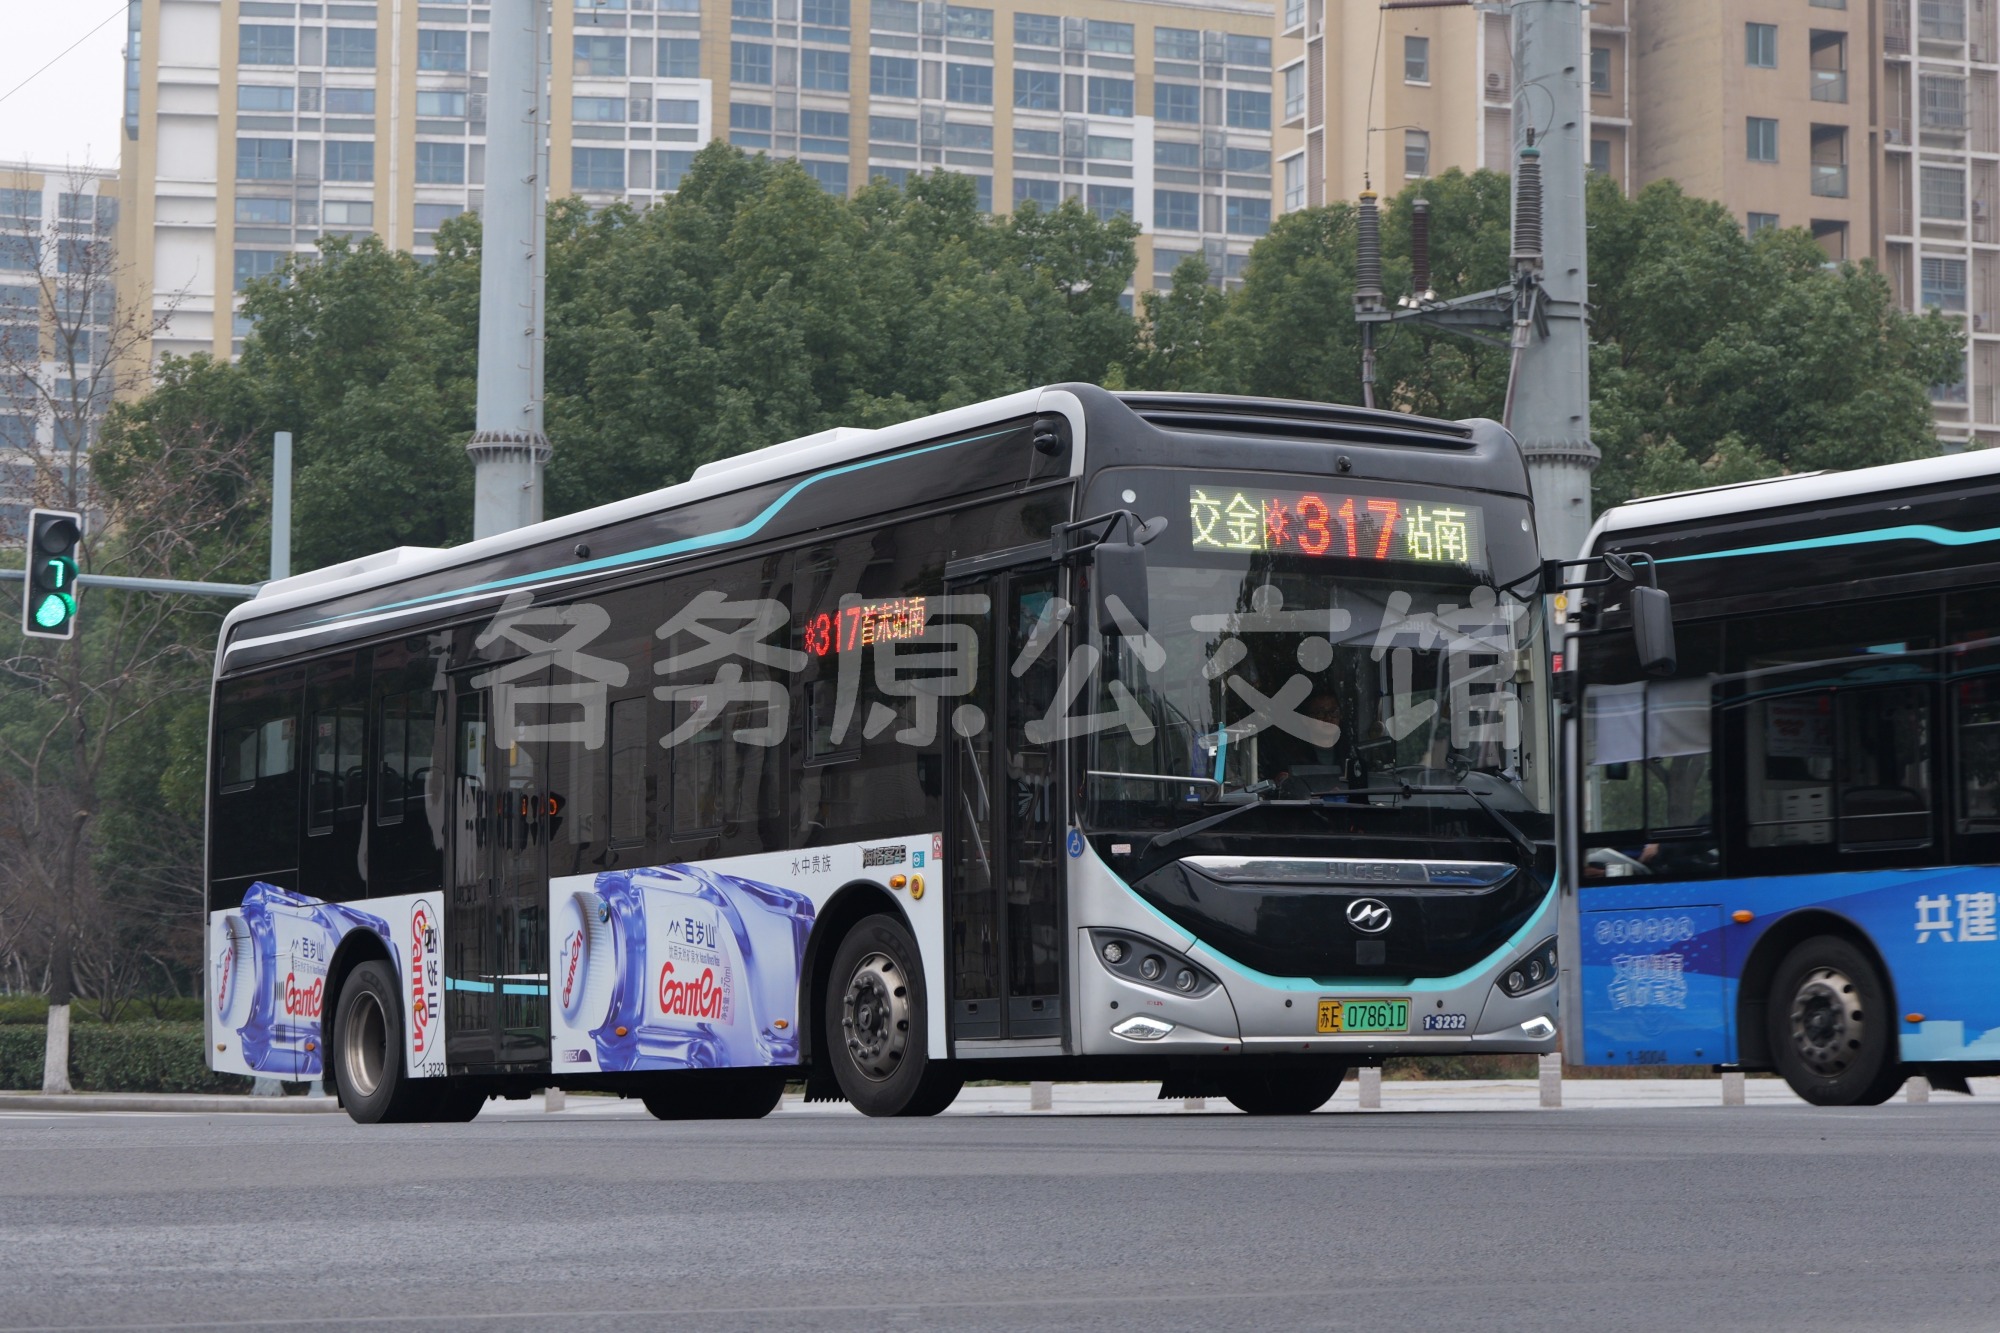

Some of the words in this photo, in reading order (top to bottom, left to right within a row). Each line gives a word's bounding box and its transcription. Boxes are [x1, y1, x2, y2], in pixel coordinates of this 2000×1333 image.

[1190, 490, 1261, 549] 交金
[1297, 496, 1401, 559] 317
[1406, 505, 1467, 562] 站南
[815, 606, 861, 656] 317
[861, 596, 926, 647] 首末站南
[791, 854, 832, 876] 水中贵族
[1325, 862, 1400, 881] HIGER
[684, 917, 715, 948] 百岁山
[1914, 892, 2000, 944] 共建
[285, 972, 323, 1018] Gante
[425, 927, 438, 1019] 百岁山
[659, 961, 723, 1020] Ganten
[422, 1062, 446, 1078] 1-3232
